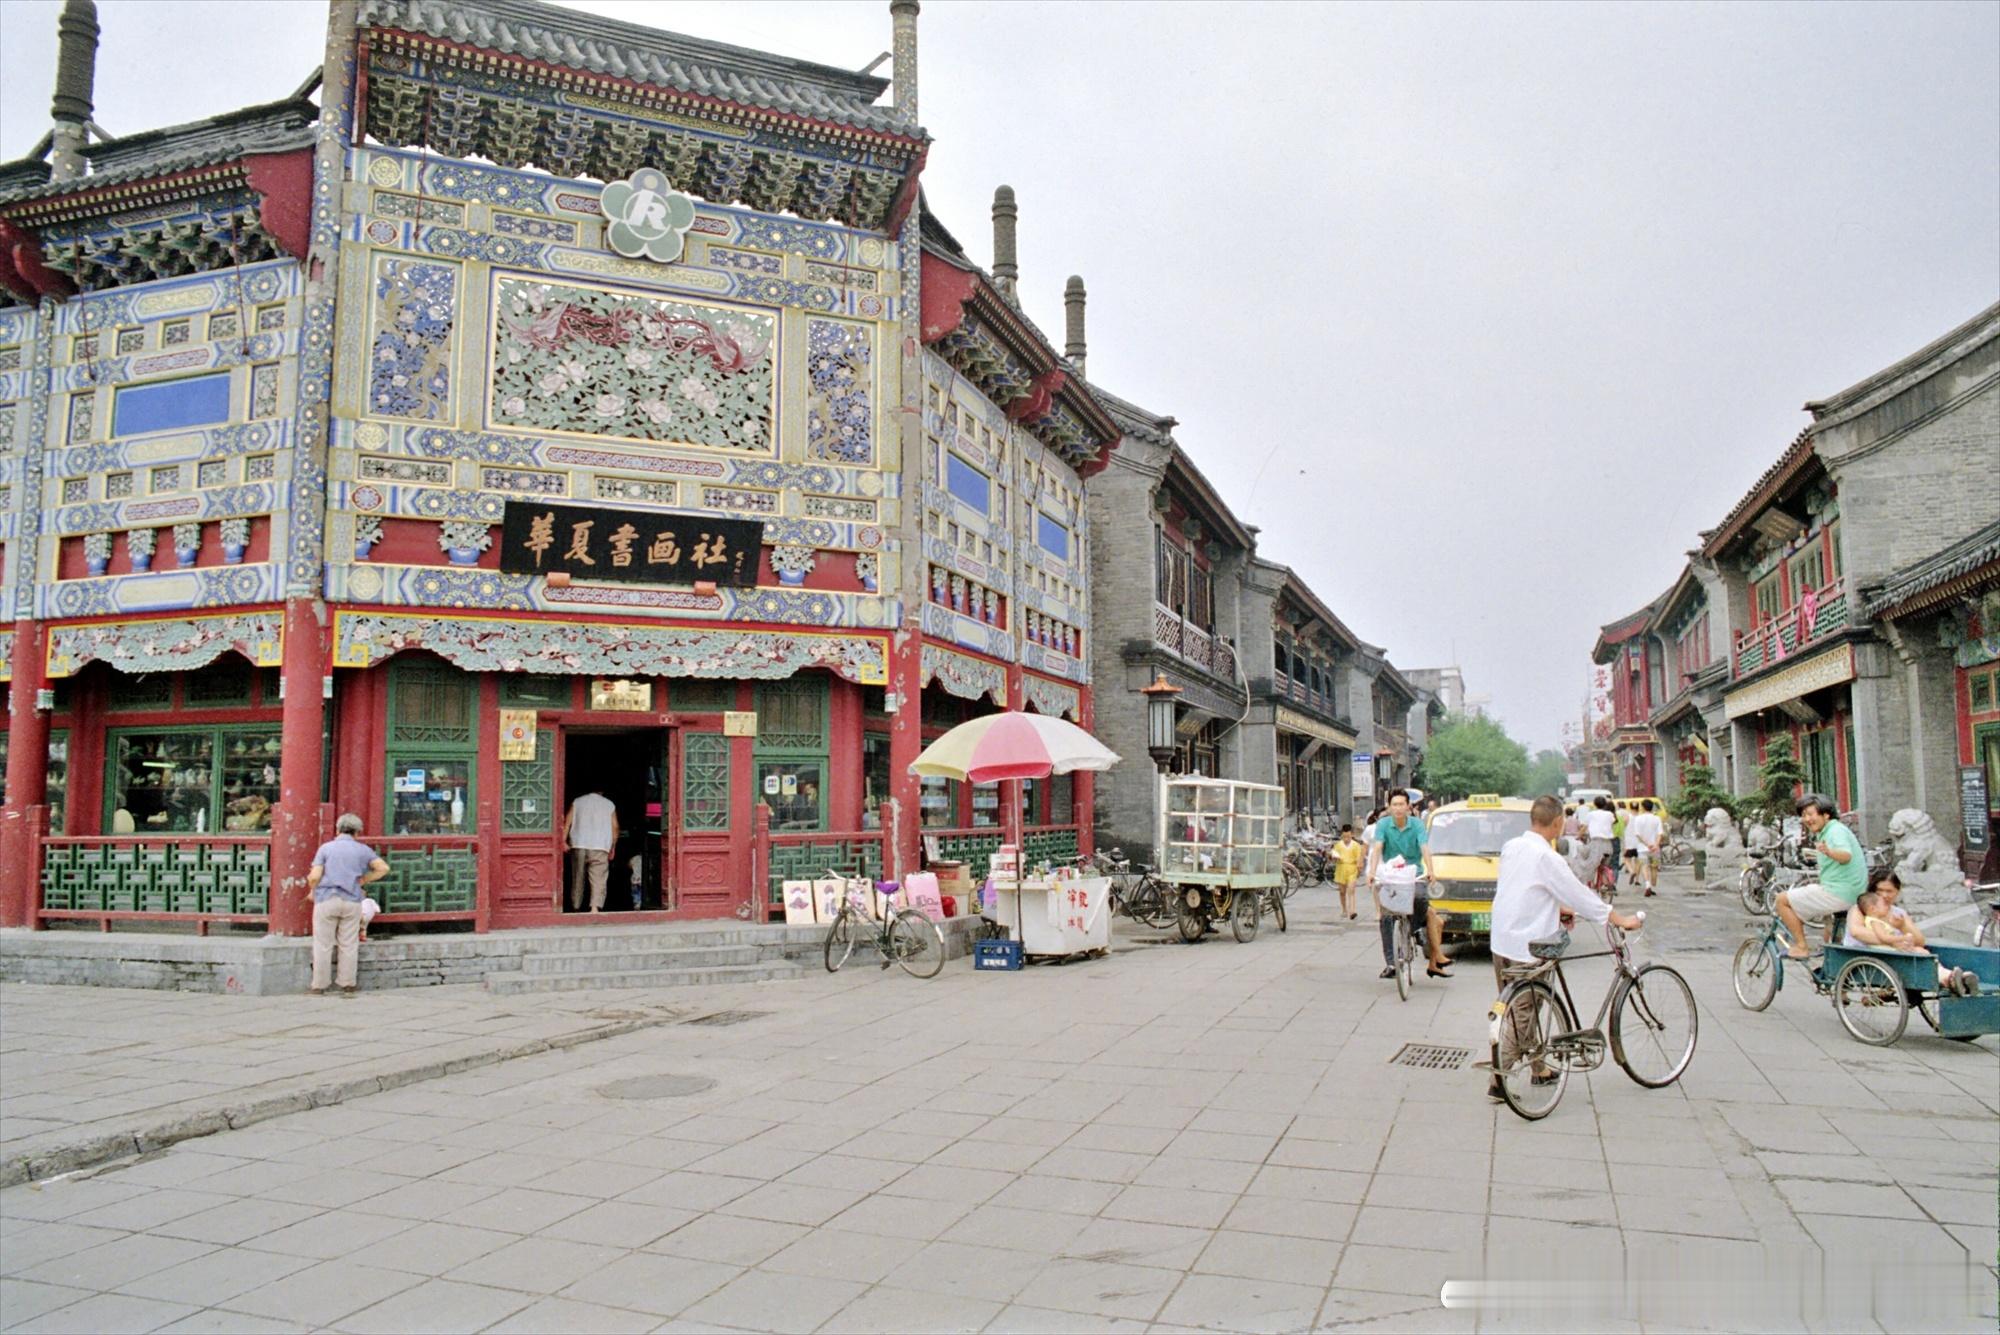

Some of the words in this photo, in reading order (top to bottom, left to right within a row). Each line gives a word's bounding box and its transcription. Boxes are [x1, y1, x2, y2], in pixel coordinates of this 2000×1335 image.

[523, 511, 728, 570] 華夏書画社
[1473, 796, 1498, 804] TAXI
